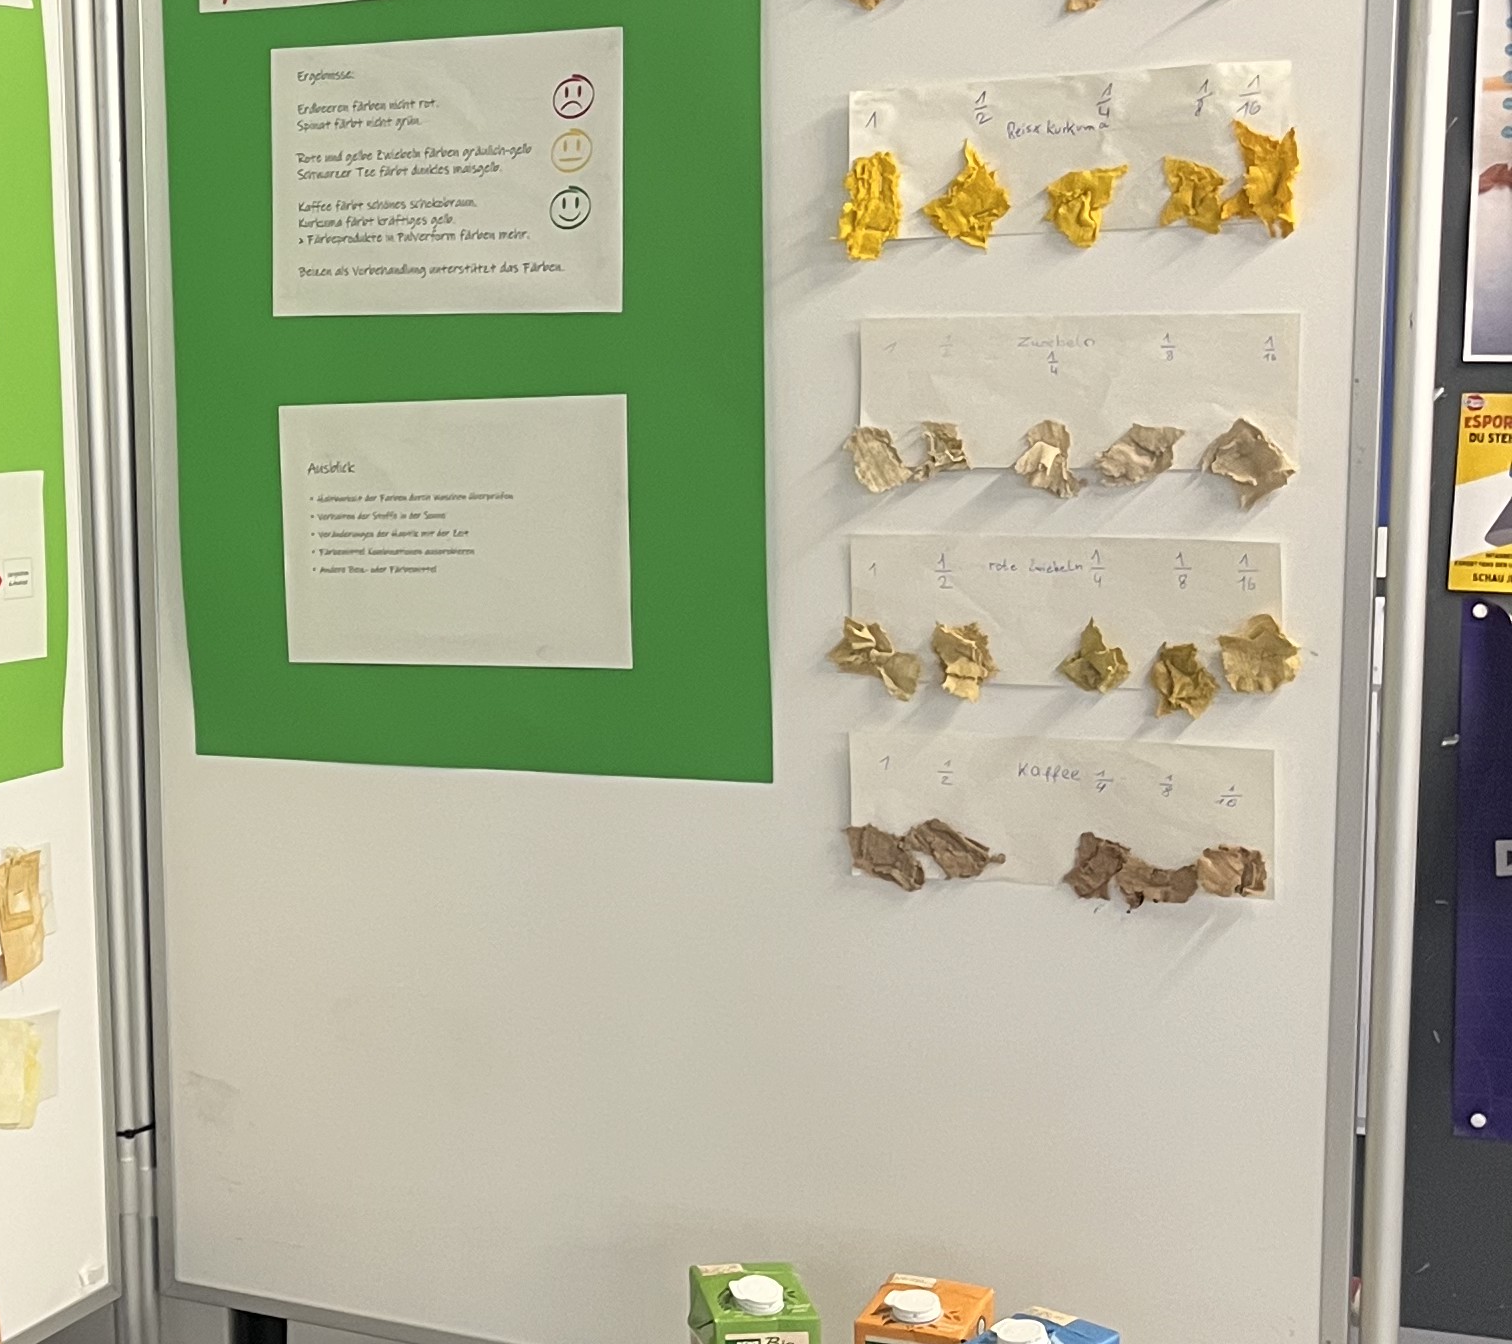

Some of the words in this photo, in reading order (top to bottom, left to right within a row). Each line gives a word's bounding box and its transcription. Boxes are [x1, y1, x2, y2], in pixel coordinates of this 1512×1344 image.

[297, 103, 349, 116] Erdbeeren
[352, 99, 387, 113] färben
[424, 145, 459, 159] färben
[356, 166, 376, 178] Tee
[379, 164, 409, 179] färbt
[298, 200, 332, 213] Kaffee
[345, 214, 375, 229] färbt
[397, 229, 457, 244] Pulverform
[460, 228, 496, 242] färben
[352, 264, 427, 280] Vorbehandlung
[428, 261, 497, 276] unterstützt
[499, 261, 519, 274] das
[1469, 432, 1484, 445] DU
[307, 460, 357, 475] Ausblick
[988, 560, 1019, 573] rote
[1472, 572, 1505, 584] SCHAU
[1018, 762, 1082, 783] Kaffee
